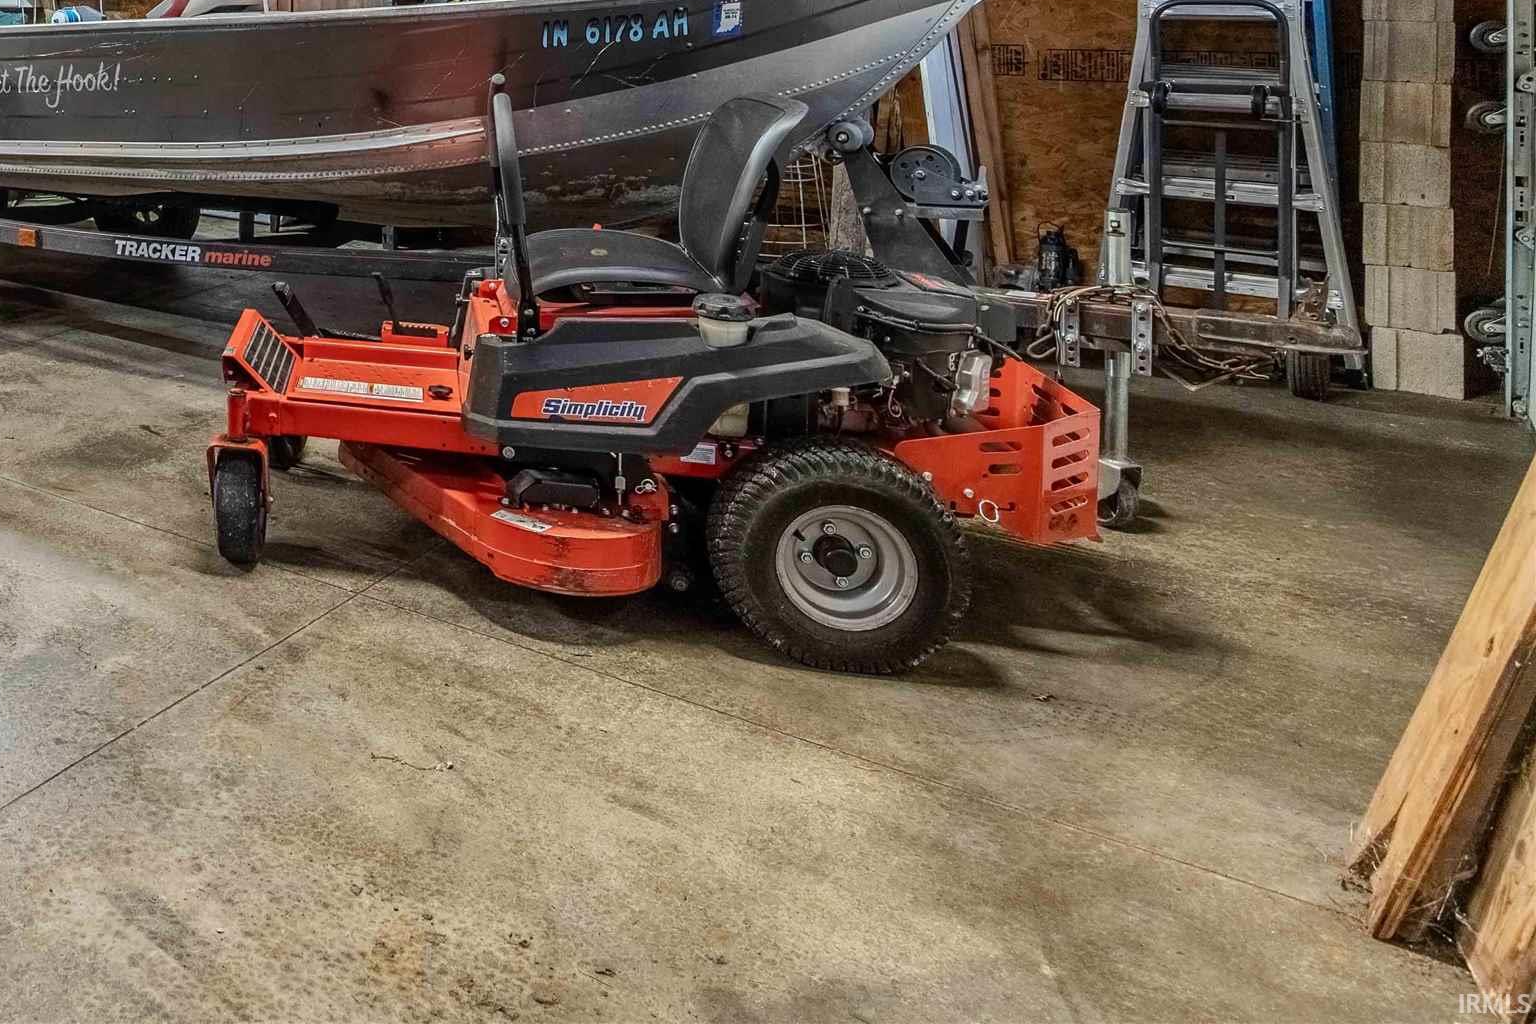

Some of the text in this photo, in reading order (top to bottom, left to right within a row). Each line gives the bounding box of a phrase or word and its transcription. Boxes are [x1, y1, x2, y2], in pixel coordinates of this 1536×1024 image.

[541, 20, 569, 49] IN
[585, 13, 644, 45] 6178
[14, 64, 51, 94] The
[45, 60, 121, 109] Hook!
[114, 239, 273, 268] TRACKER marine
[541, 397, 647, 422] Simplicity
